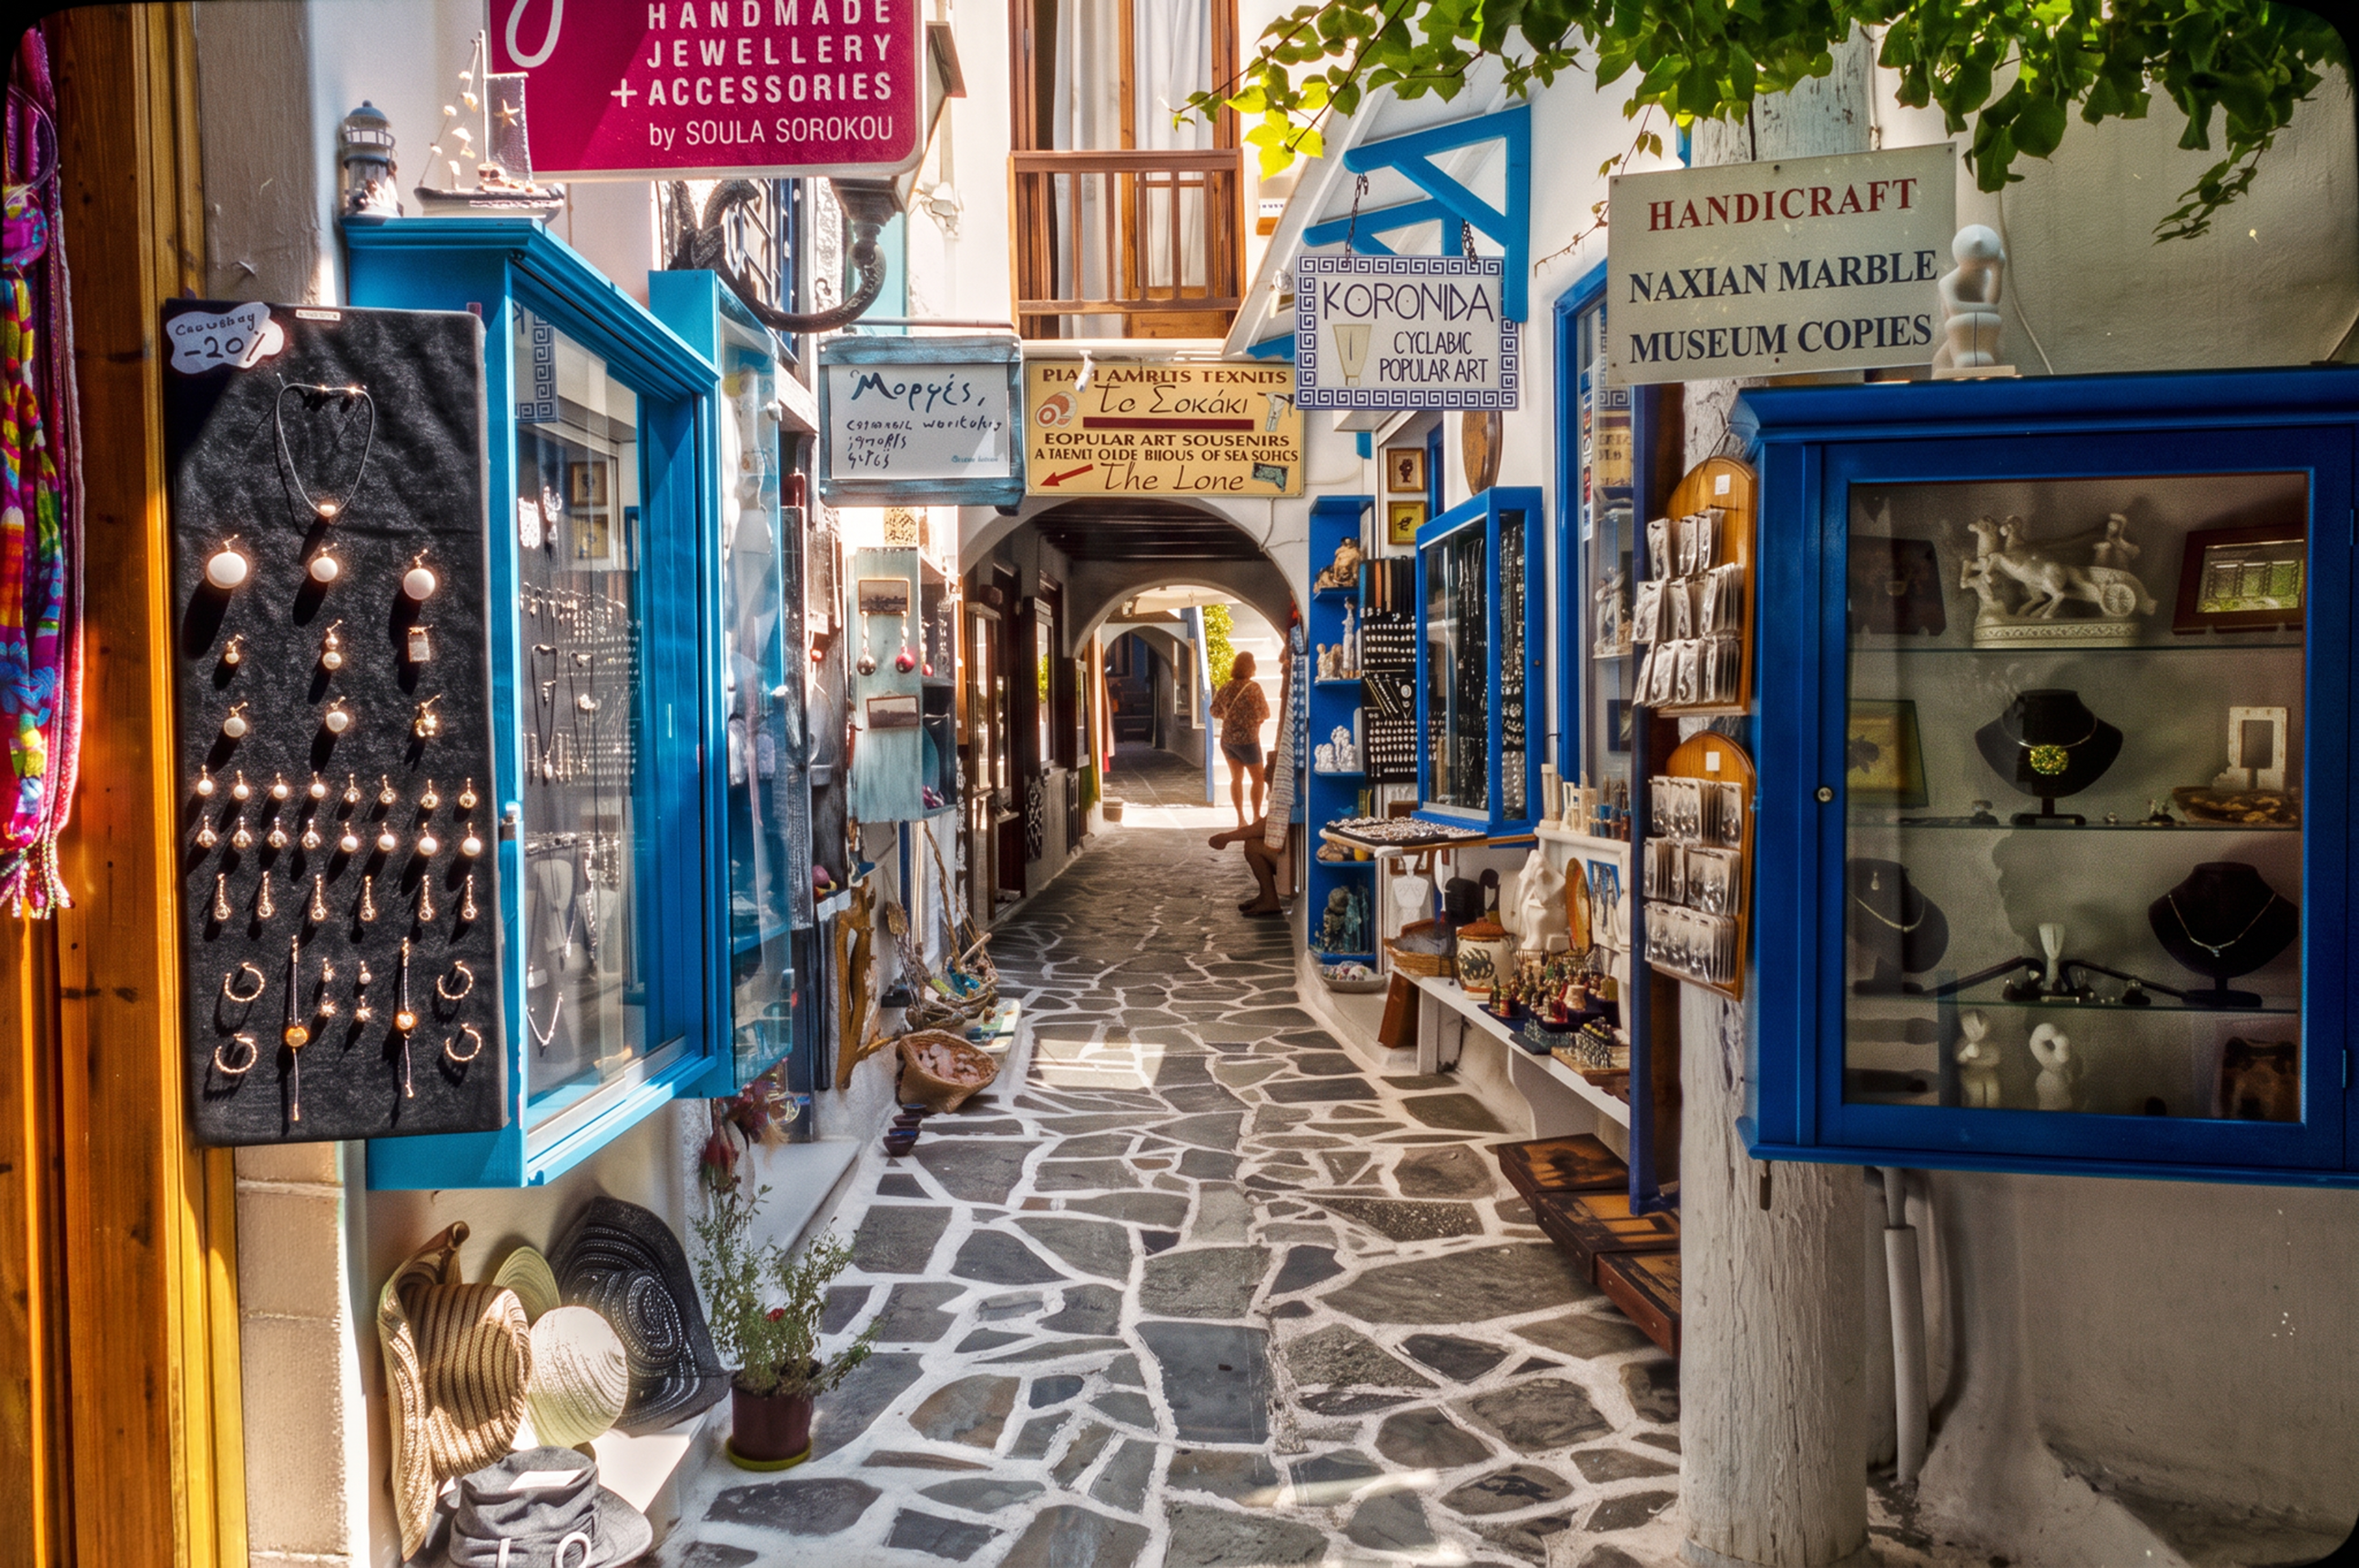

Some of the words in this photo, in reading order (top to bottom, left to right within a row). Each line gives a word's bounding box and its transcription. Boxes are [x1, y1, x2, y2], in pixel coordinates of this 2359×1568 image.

[649, 0, 890, 29] HANDMADE
[647, 34, 891, 67] JEWELLERY
[649, 72, 891, 106] ACCESSORIES
[649, 123, 675, 150] by
[686, 119, 765, 146] SOULA
[775, 116, 893, 143] SOROKOU
[1647, 178, 1917, 232] HANDICRAFT
[1629, 263, 1767, 303] NAXIAN
[1777, 250, 1938, 291] MARBLE
[1323, 281, 1493, 322] KORONIDA
[1630, 324, 1787, 363] MUSEUM
[1797, 314, 1932, 352] COPIES
[1380, 359, 1451, 382] POPULAR
[1454, 359, 1488, 382] ART
[1035, 449, 1045, 460] A
[1201, 450, 1221, 461] OF
[1224, 450, 1249, 461] SEA
[1140, 434, 1176, 446] ART
[1172, 465, 1244, 491] Lone
